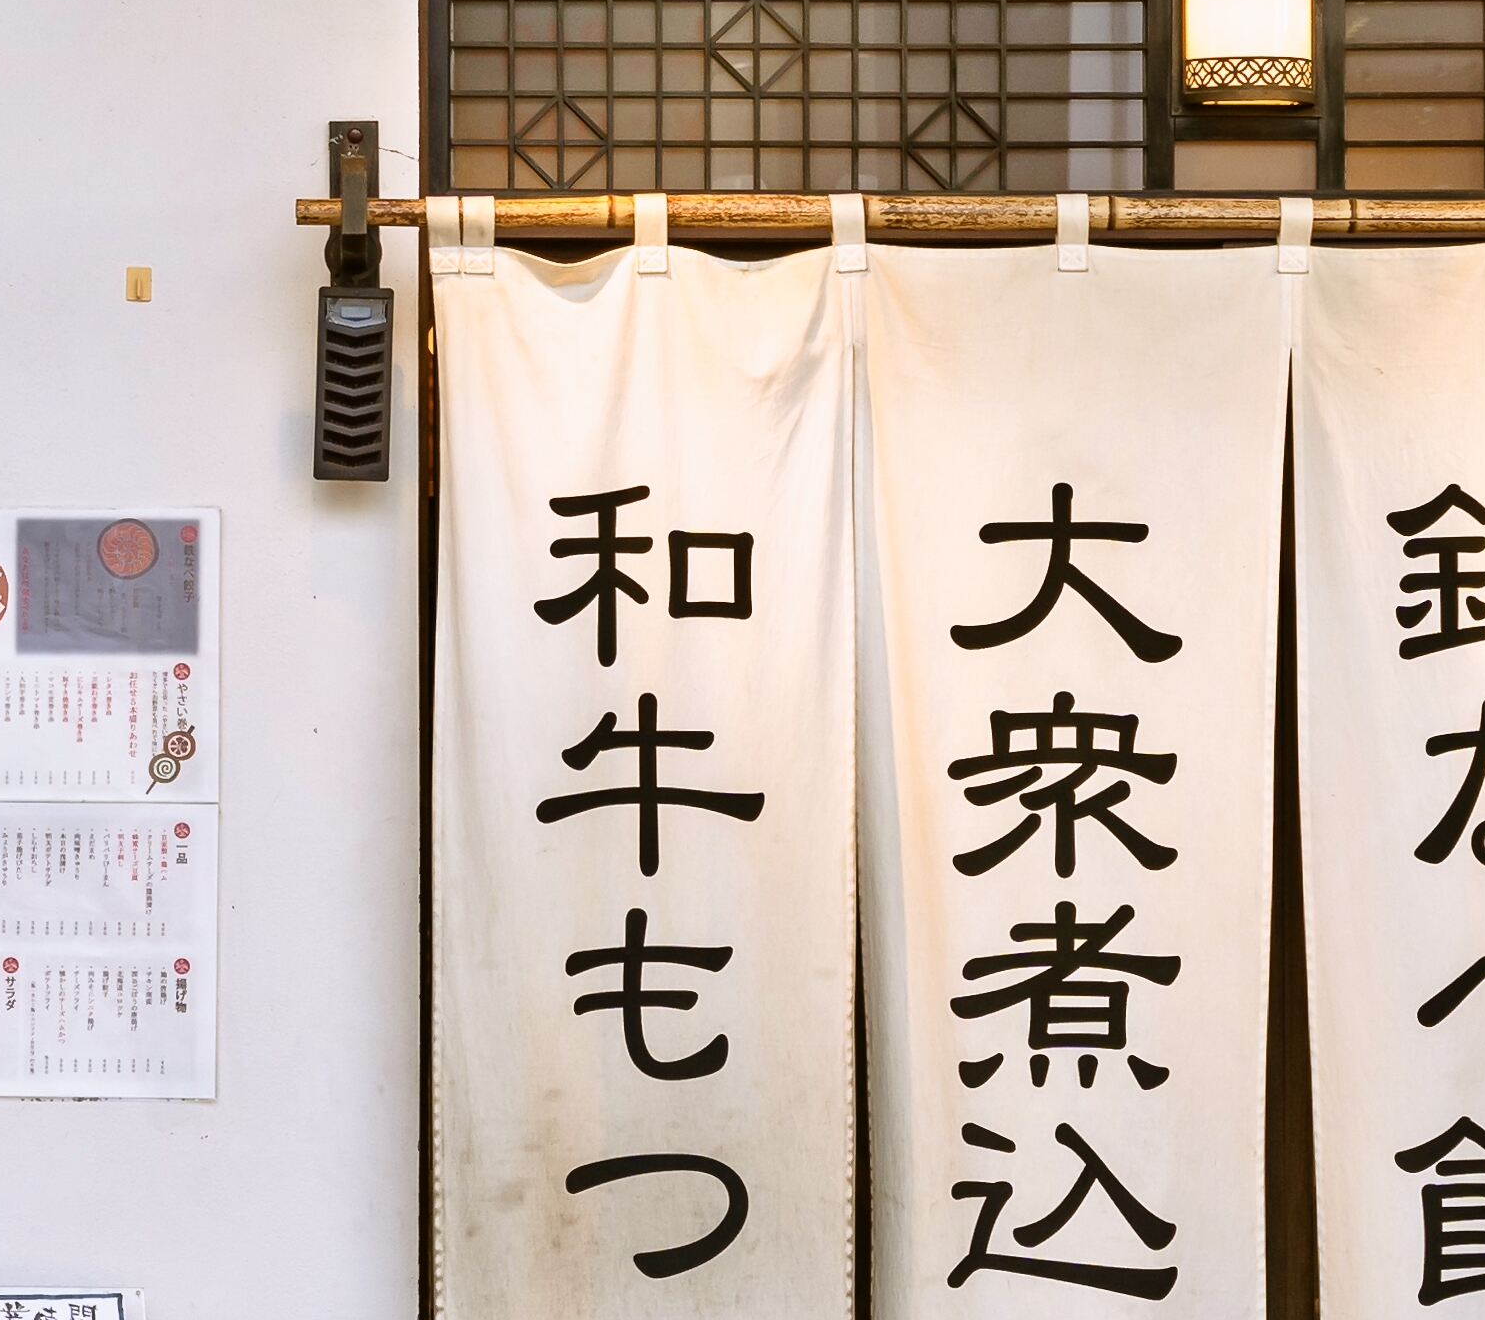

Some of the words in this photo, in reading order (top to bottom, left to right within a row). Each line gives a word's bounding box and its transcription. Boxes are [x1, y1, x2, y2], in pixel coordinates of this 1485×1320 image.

[175, 844, 189, 865] 一品
[5, 976, 17, 1011] サラダ
[175, 978, 187, 1013] 揚げ物
